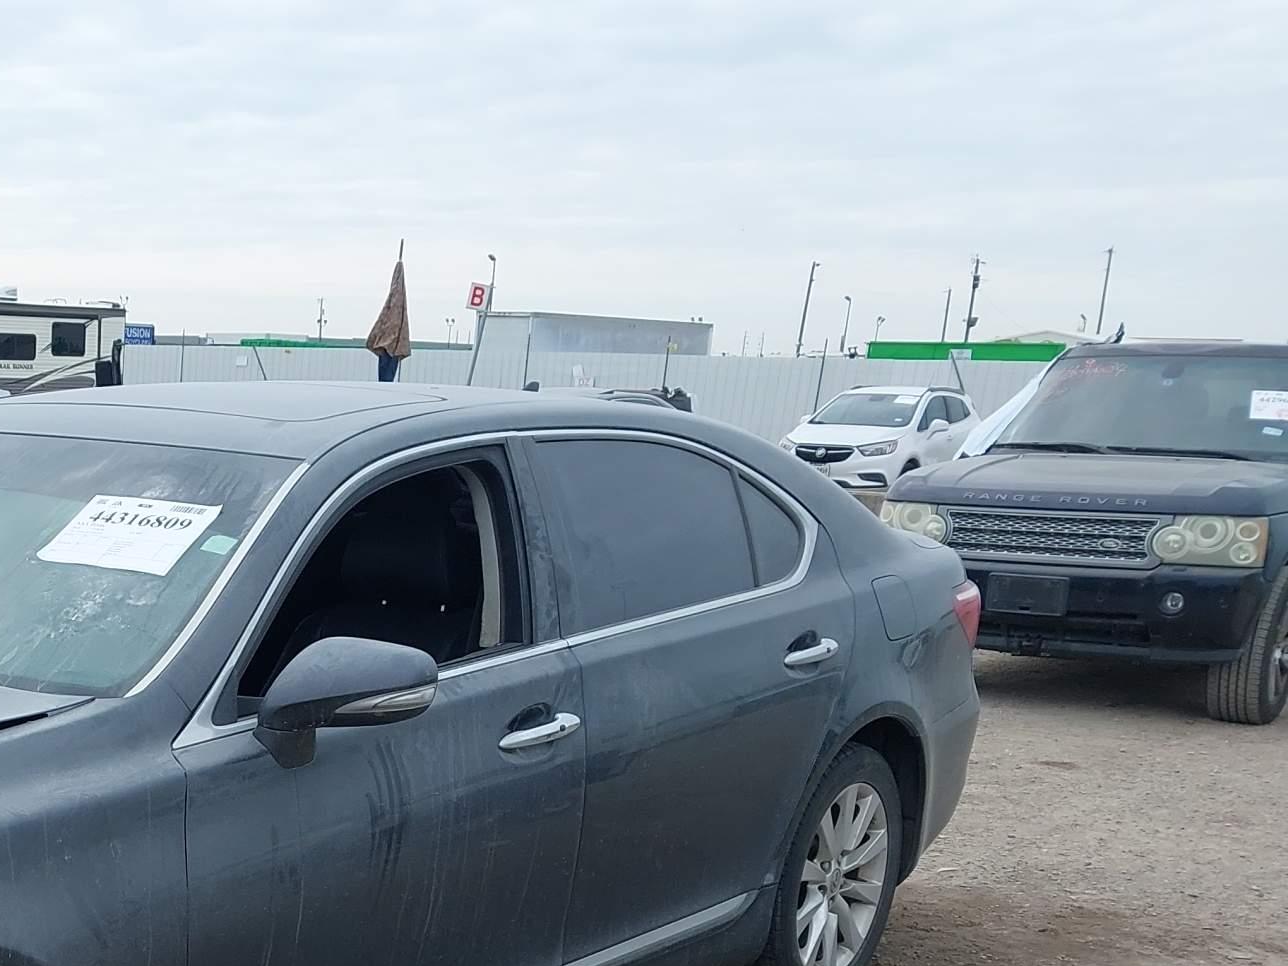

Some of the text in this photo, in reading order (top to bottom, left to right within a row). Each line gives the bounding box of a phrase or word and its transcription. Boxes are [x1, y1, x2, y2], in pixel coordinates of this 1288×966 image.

[470, 286, 485, 307] B
[962, 491, 1148, 506] RANGE ROVER
[89, 510, 193, 531] 44316809
